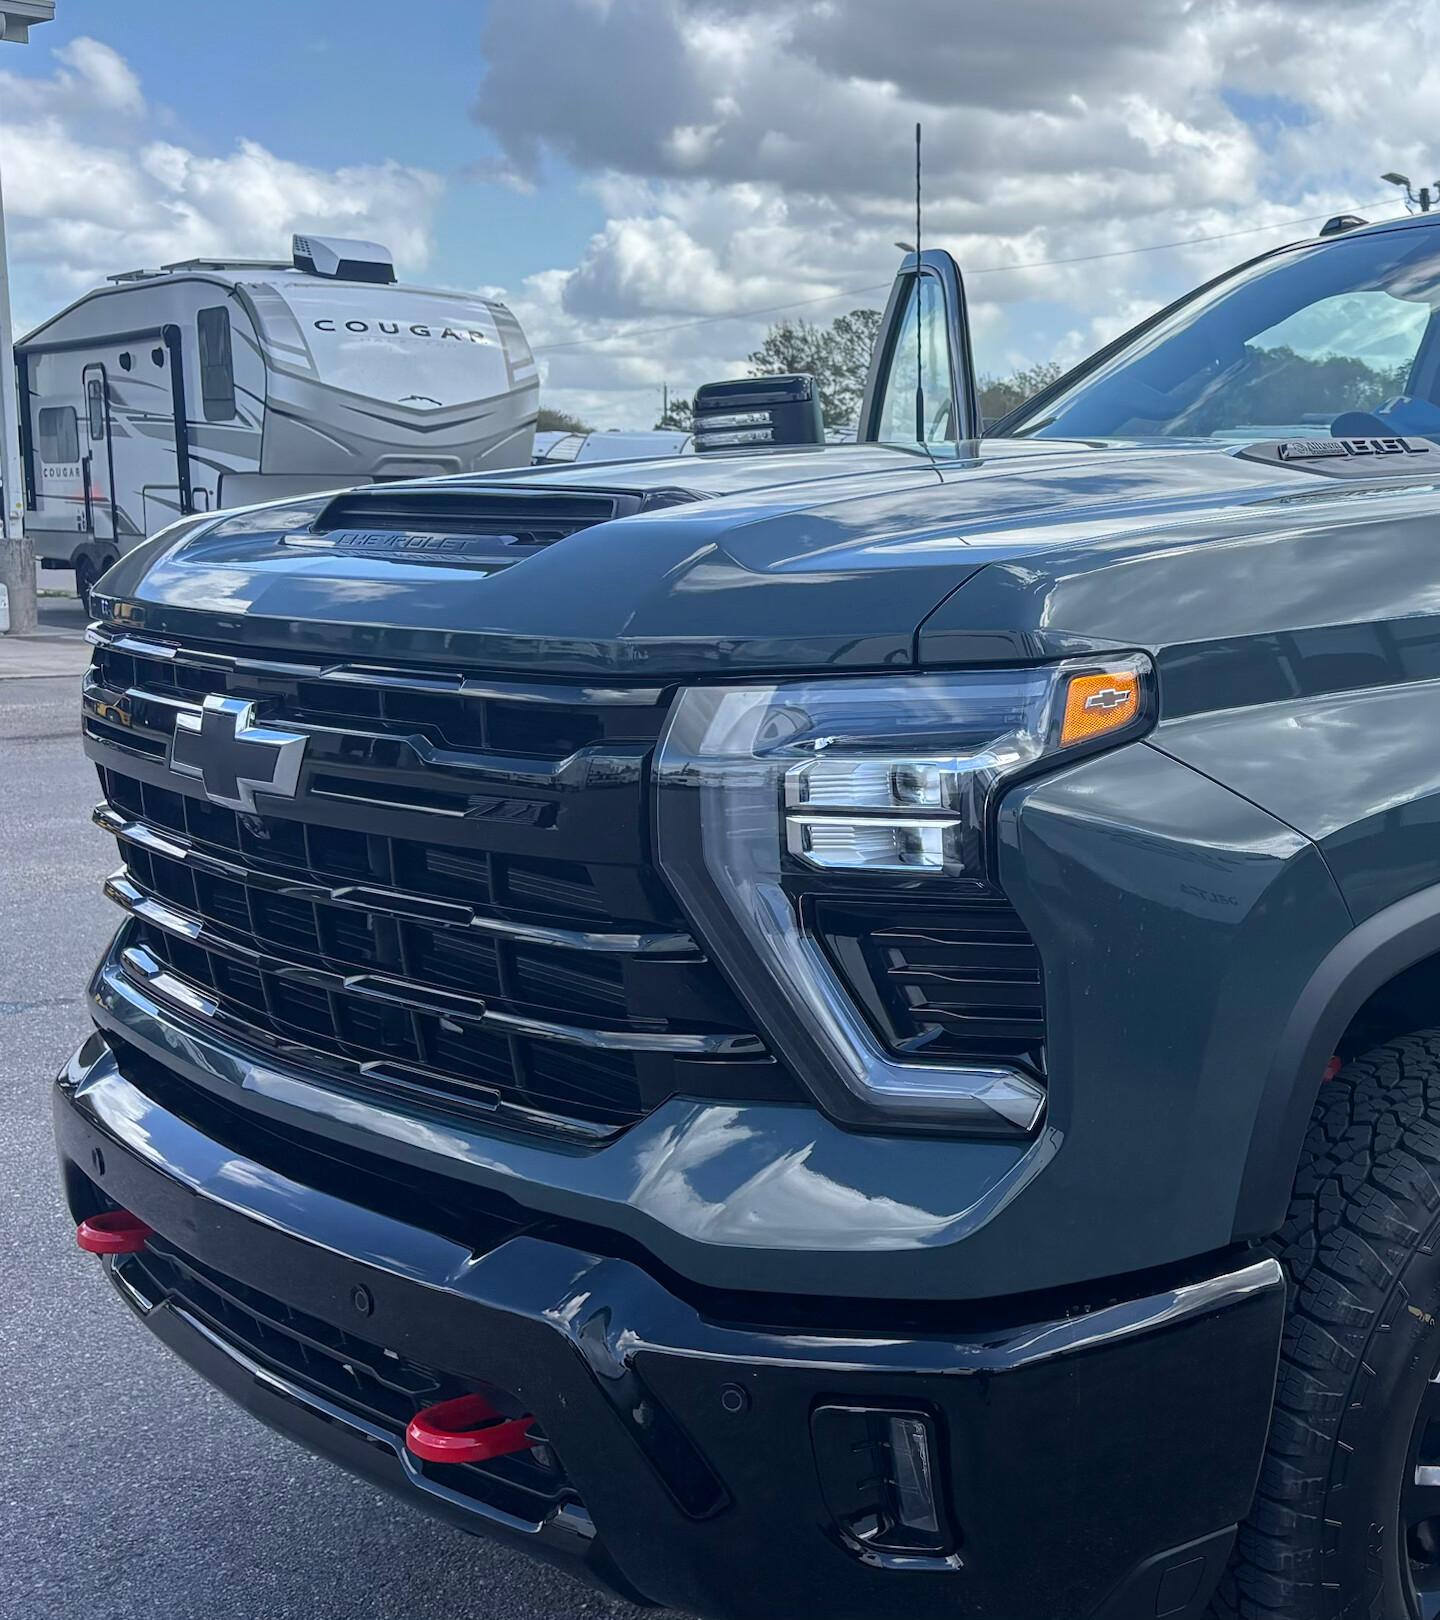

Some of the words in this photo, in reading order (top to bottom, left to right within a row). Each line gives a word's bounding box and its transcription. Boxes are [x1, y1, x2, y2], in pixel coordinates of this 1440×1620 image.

[314, 320, 486, 343] COUGAR
[43, 467, 81, 478] COUGAR
[337, 533, 478, 551] CHEVROLET
